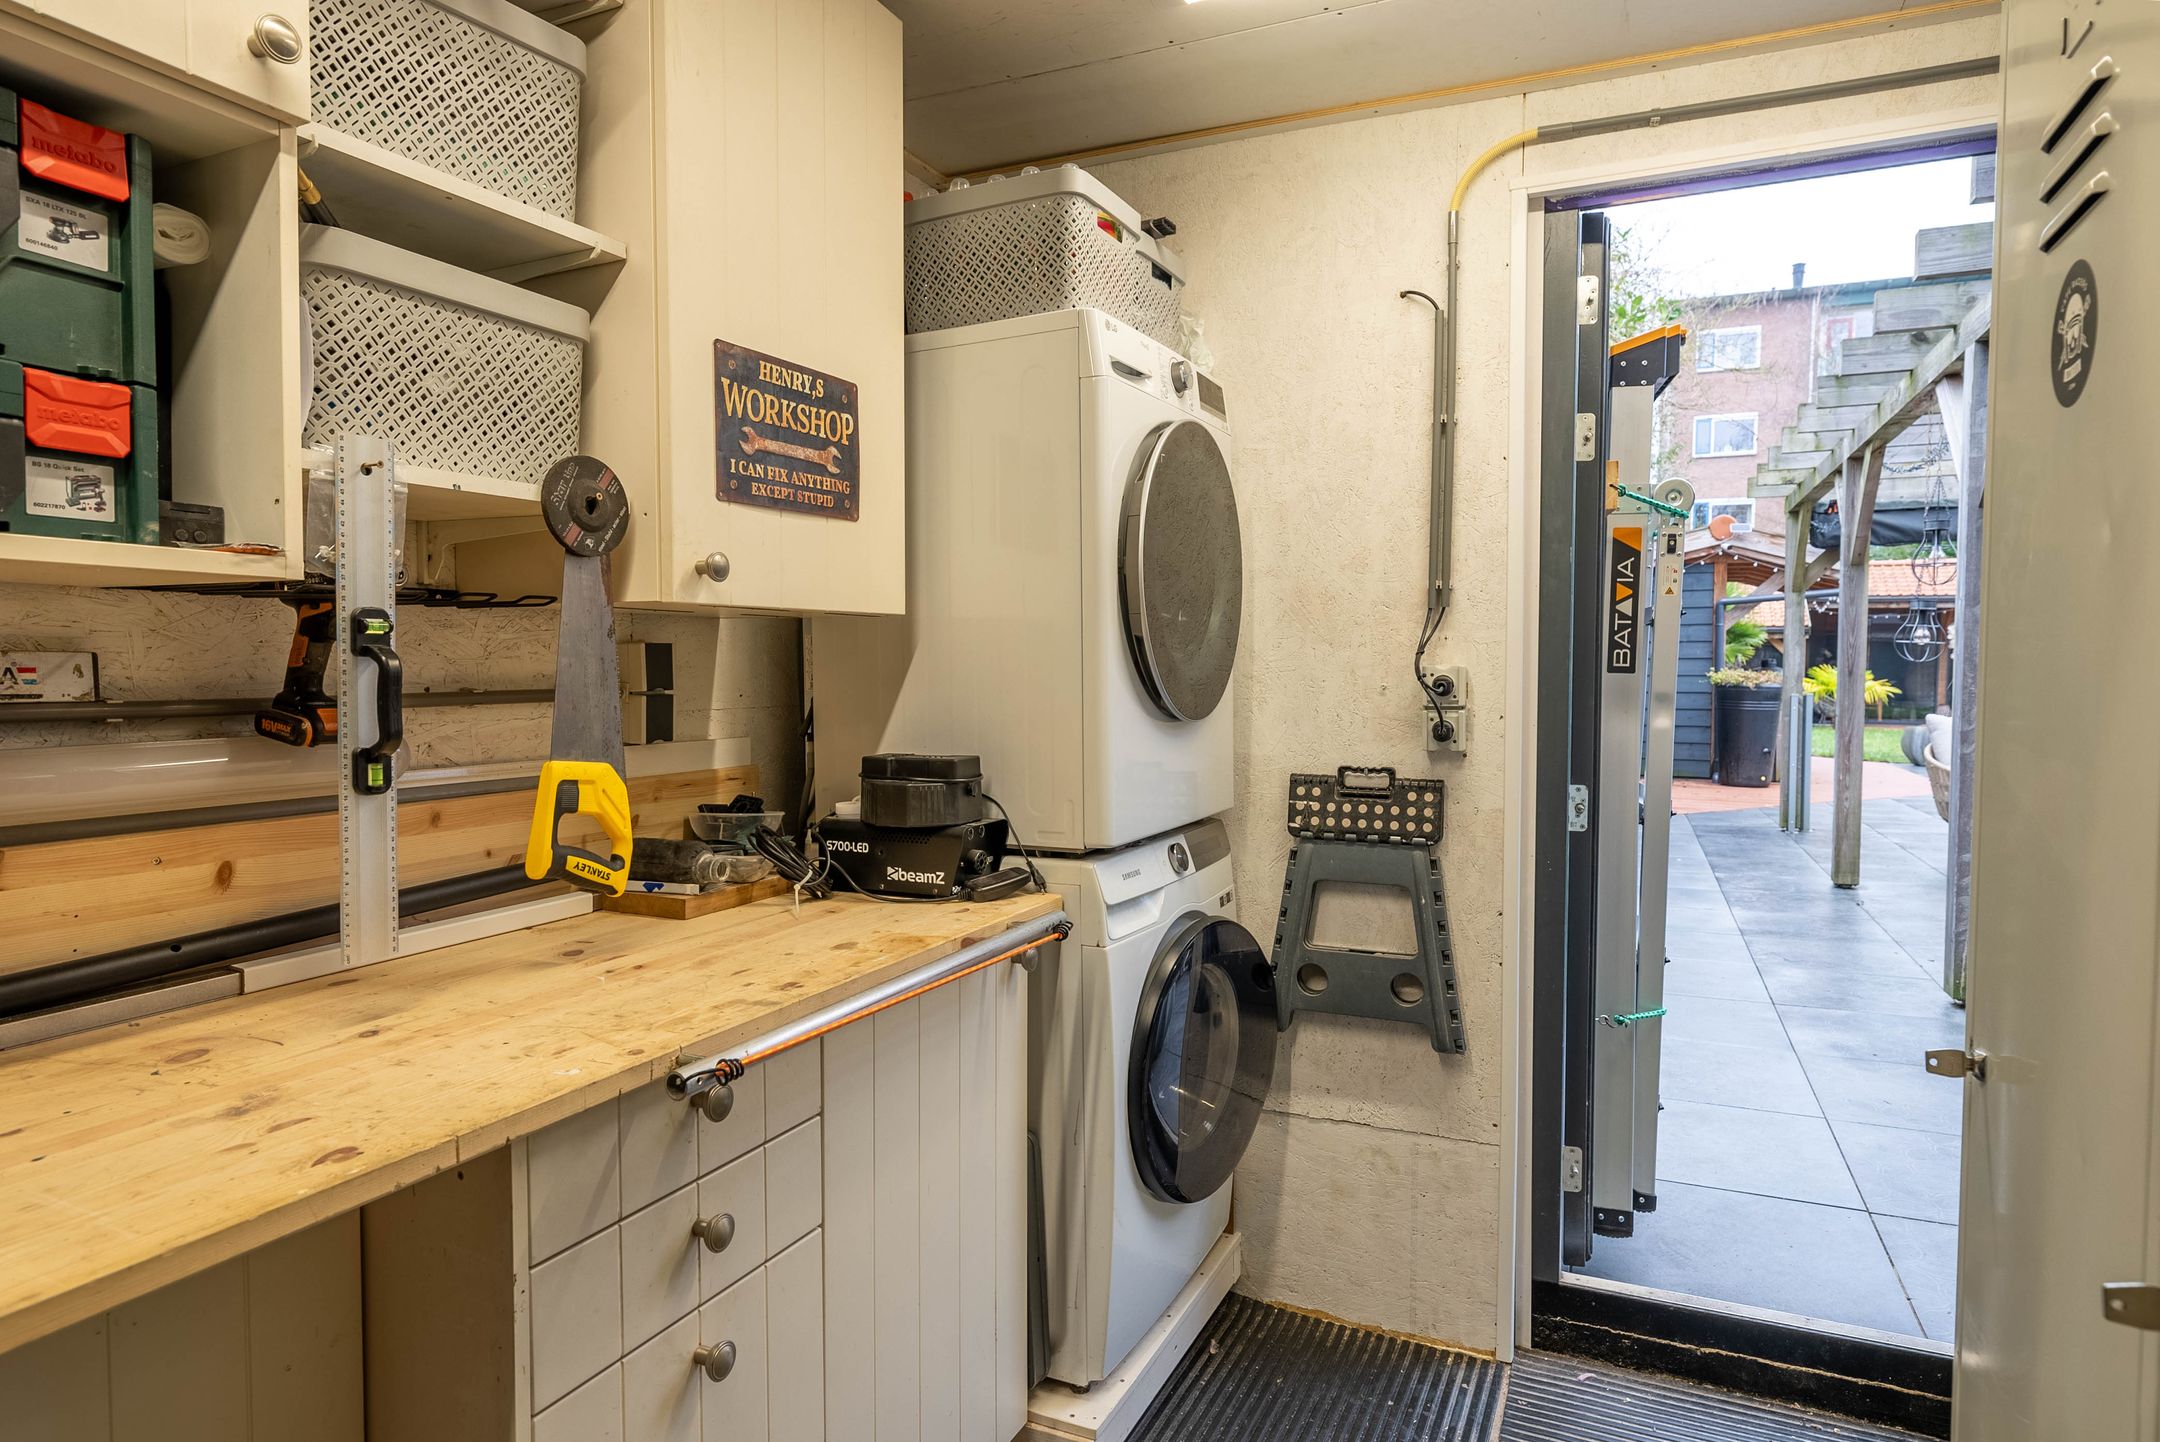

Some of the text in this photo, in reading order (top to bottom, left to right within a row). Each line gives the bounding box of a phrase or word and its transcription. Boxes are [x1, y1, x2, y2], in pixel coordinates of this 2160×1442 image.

[31, 136, 117, 173] metabo
[42, 201, 50, 209] 18
[51, 203, 64, 212] LTX
[66, 208, 77, 217] 125
[36, 406, 121, 430] metabo
[721, 376, 854, 446] WORKSHOP
[730, 458, 851, 495] I CAN FIX ANYTHING
[751, 481, 834, 508] EXCEPT STUPID
[1612, 557, 1635, 667] BATAVIA
[826, 840, 869, 853] S700-LED
[573, 862, 611, 881] STANLEY
[1121, 868, 1142, 881] SAMSUNG
